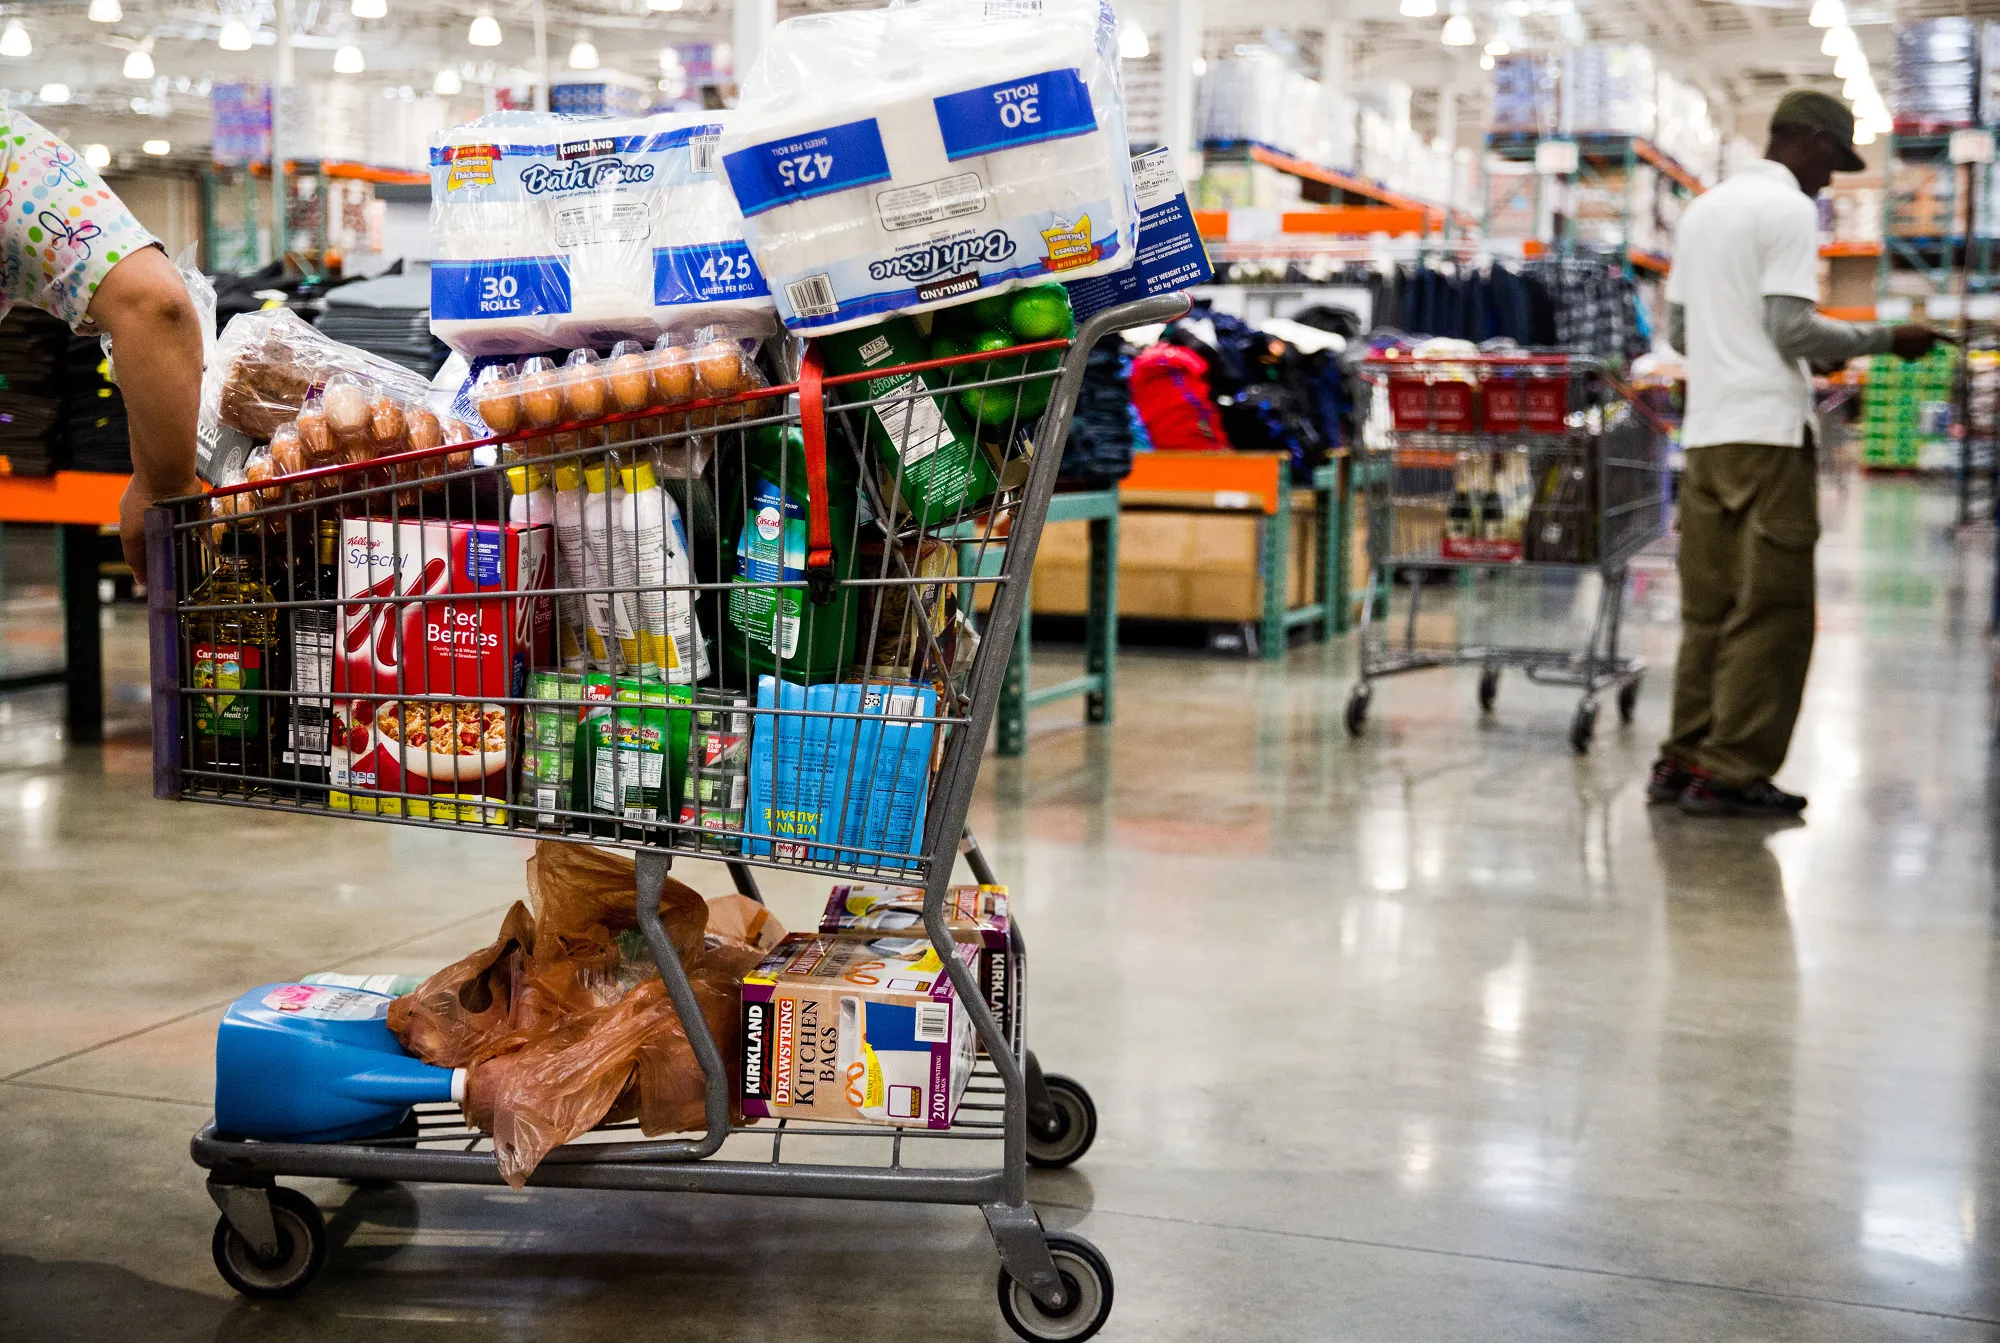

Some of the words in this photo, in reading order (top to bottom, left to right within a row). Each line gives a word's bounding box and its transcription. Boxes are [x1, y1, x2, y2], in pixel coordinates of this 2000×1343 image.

[993, 83, 1039, 103] ROLLS
[1000, 98, 1041, 128] 30
[559, 140, 614, 155] KIRKLAND
[771, 144, 790, 156] ROLL
[790, 141, 803, 152] PER
[803, 136, 828, 151] SHEETS
[456, 159, 488, 168] Softness
[777, 155, 834, 186] 425
[454, 171, 490, 181] Thickness
[1166, 206, 1181, 215] U.S.A.
[1158, 218, 1168, 228] DES
[1048, 232, 1087, 243] Thickness
[1054, 243, 1089, 256] Softness
[699, 253, 750, 281] 425
[1057, 255, 1092, 269] PREMIUM
[1146, 275, 1159, 286] NET
[1159, 268, 1182, 281] WEIGHT
[1182, 264, 1191, 273] 13
[1148, 283, 1163, 294] 5.90
[1162, 280, 1172, 291] kg
[1171, 274, 1189, 286] POIDS
[1189, 269, 1202, 280] NET
[482, 276, 518, 298] 30
[725, 285, 738, 293] PER
[738, 284, 754, 292] ROLL
[920, 278, 979, 301] KIRKLAND
[481, 299, 521, 312] ROLLS
[860, 336, 887, 355] TATE'S
[755, 515, 781, 528] Cascad
[443, 606, 483, 627] Red
[427, 623, 498, 647] Berries
[223, 711, 250, 720] Healty
[645, 729, 660, 739] Sea
[746, 1004, 763, 1095] KIRKLAND
[776, 1000, 793, 1104] DRAWSTRING
[794, 999, 820, 1108] KITCHEN
[819, 1026, 838, 1084] BAGS
[932, 1093, 946, 1120] 200
